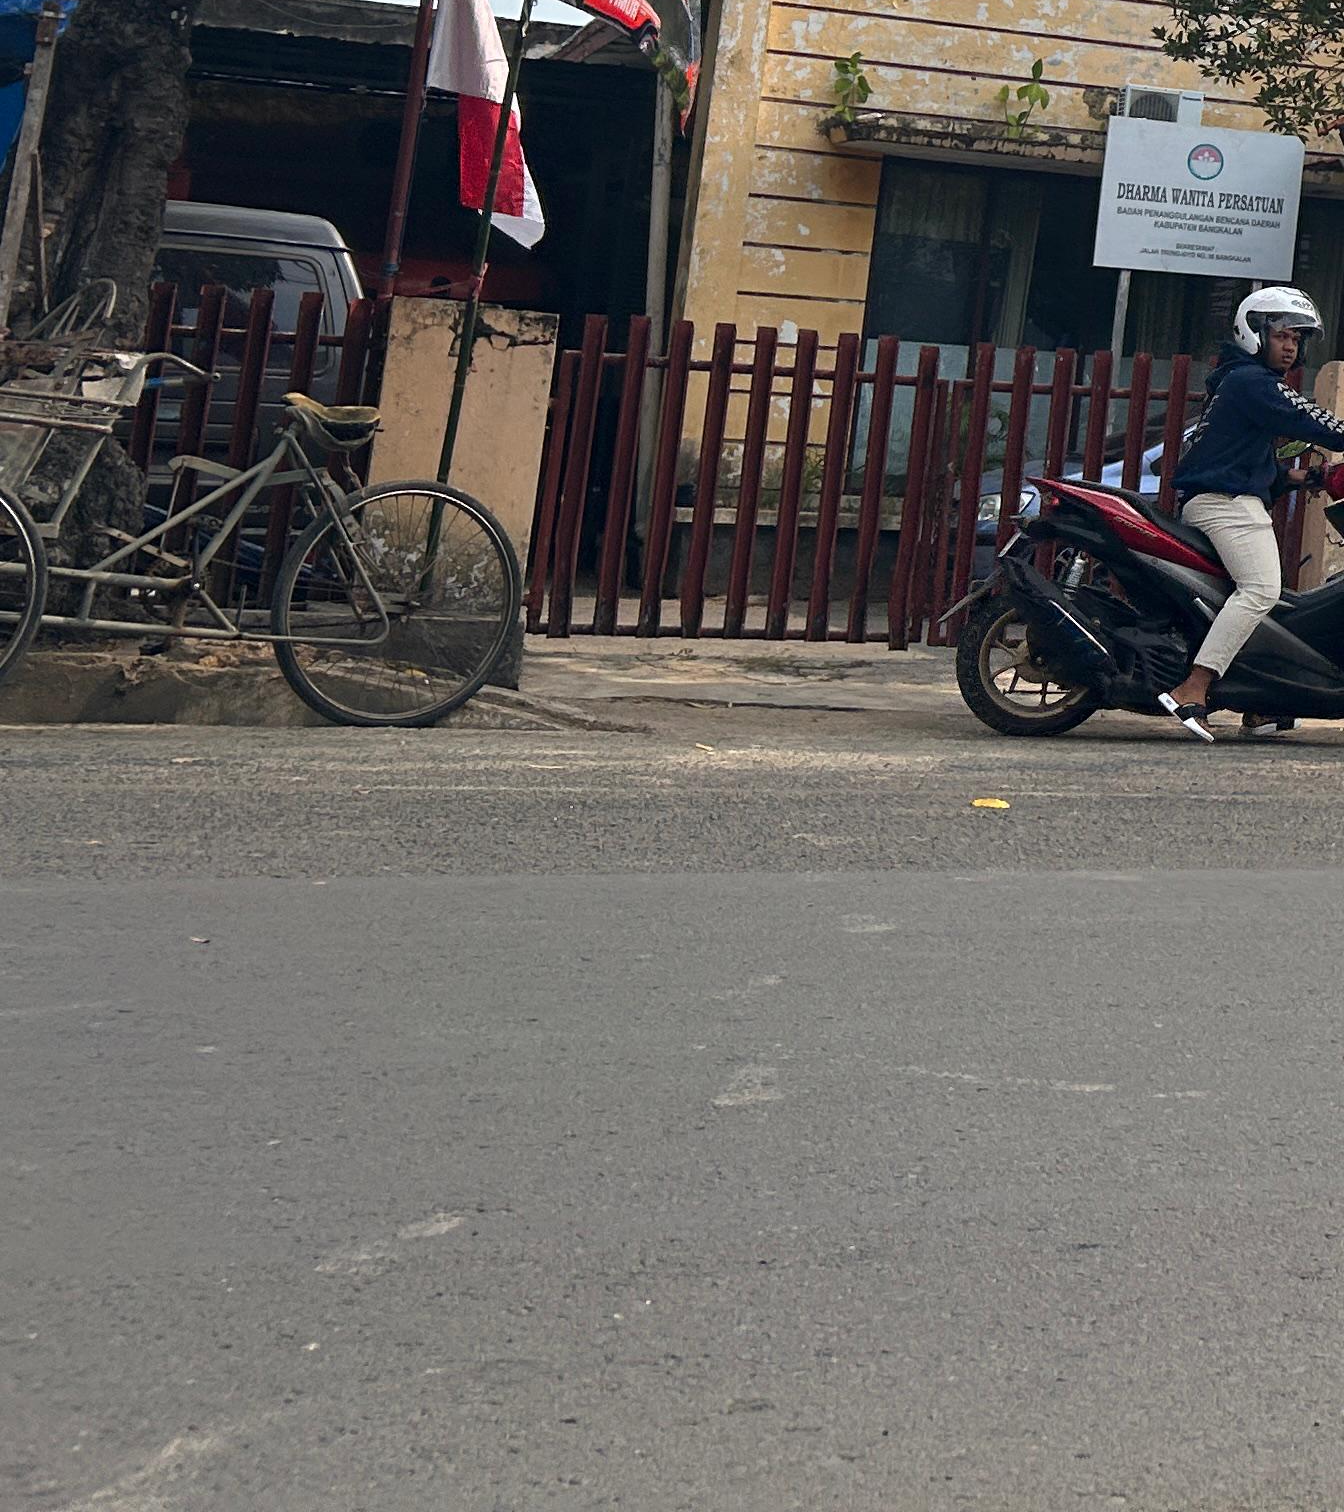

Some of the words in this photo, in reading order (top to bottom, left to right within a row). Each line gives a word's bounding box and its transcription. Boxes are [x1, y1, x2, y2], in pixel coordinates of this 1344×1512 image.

[1117, 182, 1167, 203] DHARMA
[1172, 188, 1214, 207] WANITA
[1218, 192, 1285, 214] PERSATUAN
[1117, 206, 1143, 216] BADAN
[1144, 208, 1214, 223] PENANGGULANGAN
[1215, 216, 1250, 226] BENCANA
[1251, 219, 1281, 229] DAERAH
[1153, 220, 1197, 232] KABUPATEN
[1198, 224, 1243, 235] BANGKALAN
